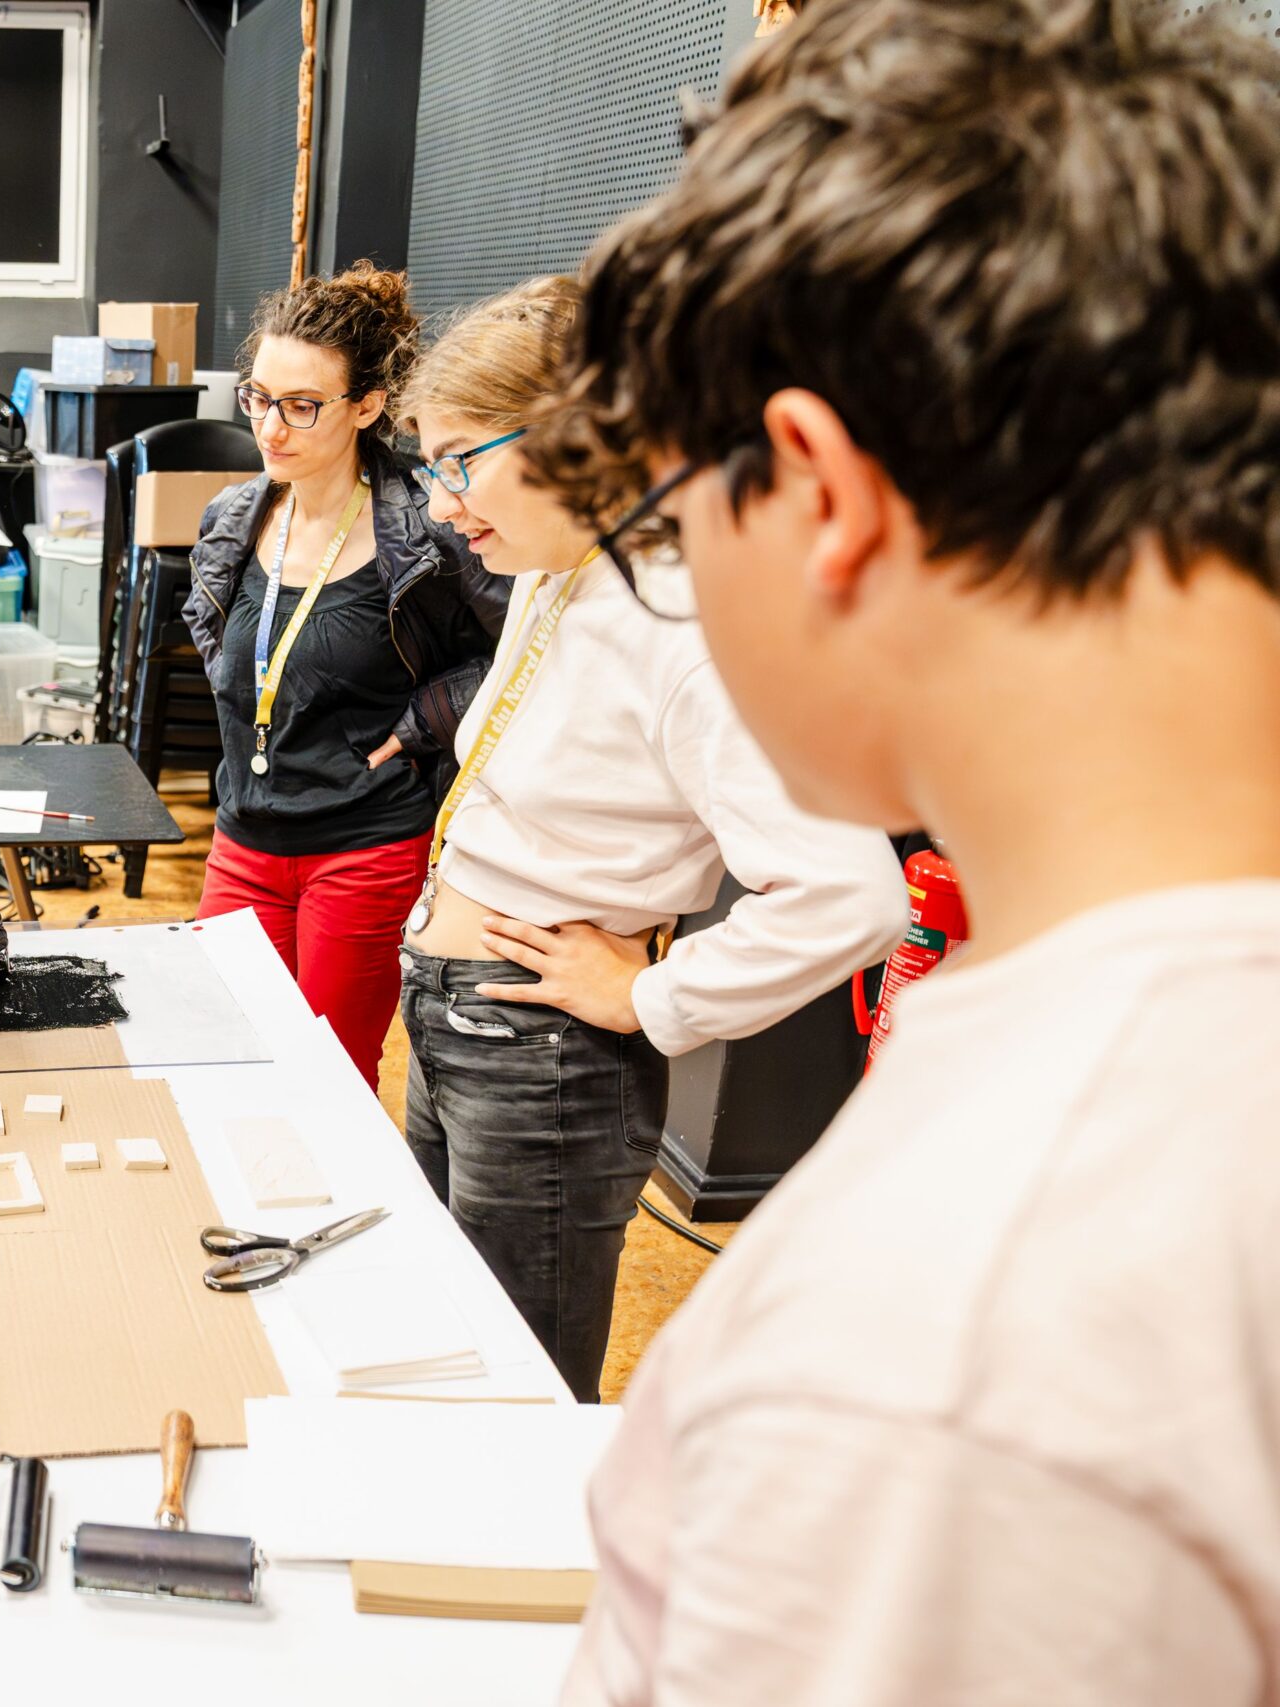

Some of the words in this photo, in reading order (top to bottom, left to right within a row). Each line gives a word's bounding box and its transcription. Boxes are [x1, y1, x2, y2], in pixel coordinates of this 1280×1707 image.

[264, 571, 281, 611] Wiltz
[291, 605, 307, 627] du
[301, 569, 325, 606] Nord
[320, 530, 347, 570] Wiltz
[447, 732, 497, 812] Internat
[491, 708, 510, 734] du
[503, 651, 540, 703] Nord
[531, 597, 565, 650] Wiltz
